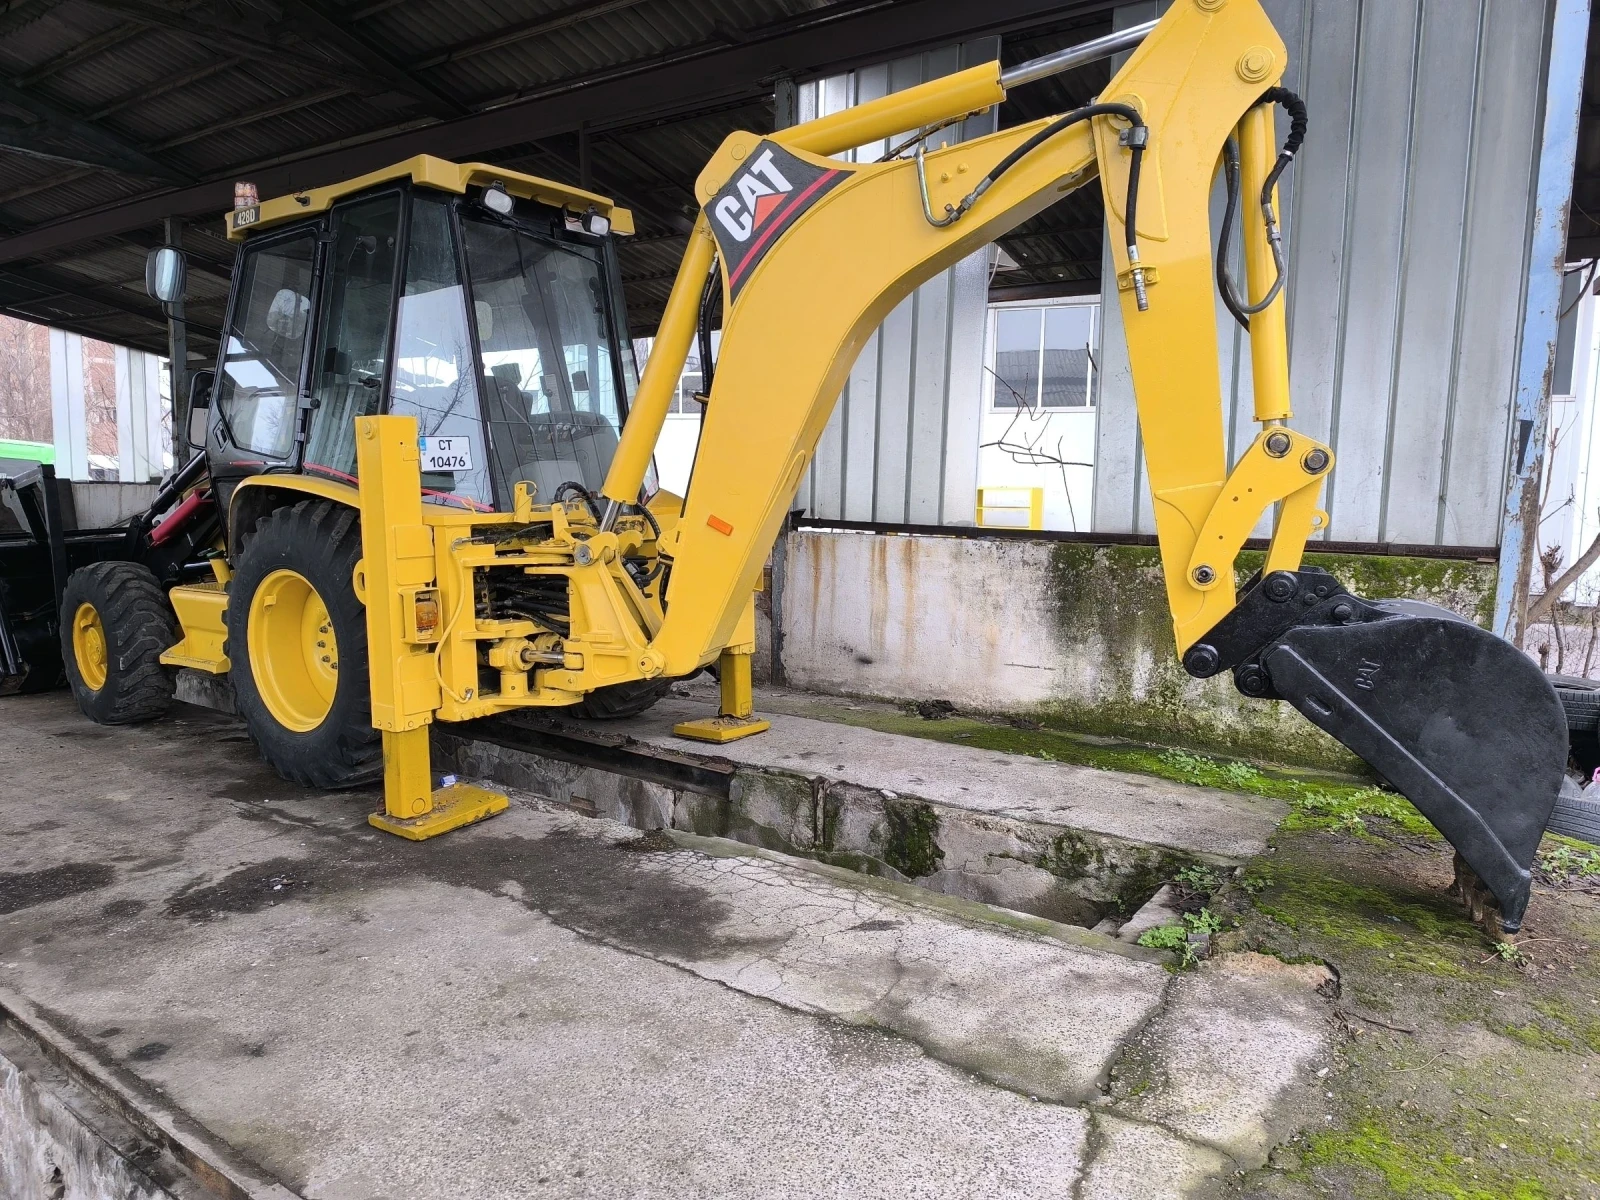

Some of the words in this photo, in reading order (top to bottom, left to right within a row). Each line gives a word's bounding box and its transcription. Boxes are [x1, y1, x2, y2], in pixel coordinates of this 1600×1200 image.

[715, 148, 794, 242] CAT
[237, 209, 255, 225] 428D
[438, 439, 452, 451] CT
[430, 456, 466, 468] 10476
